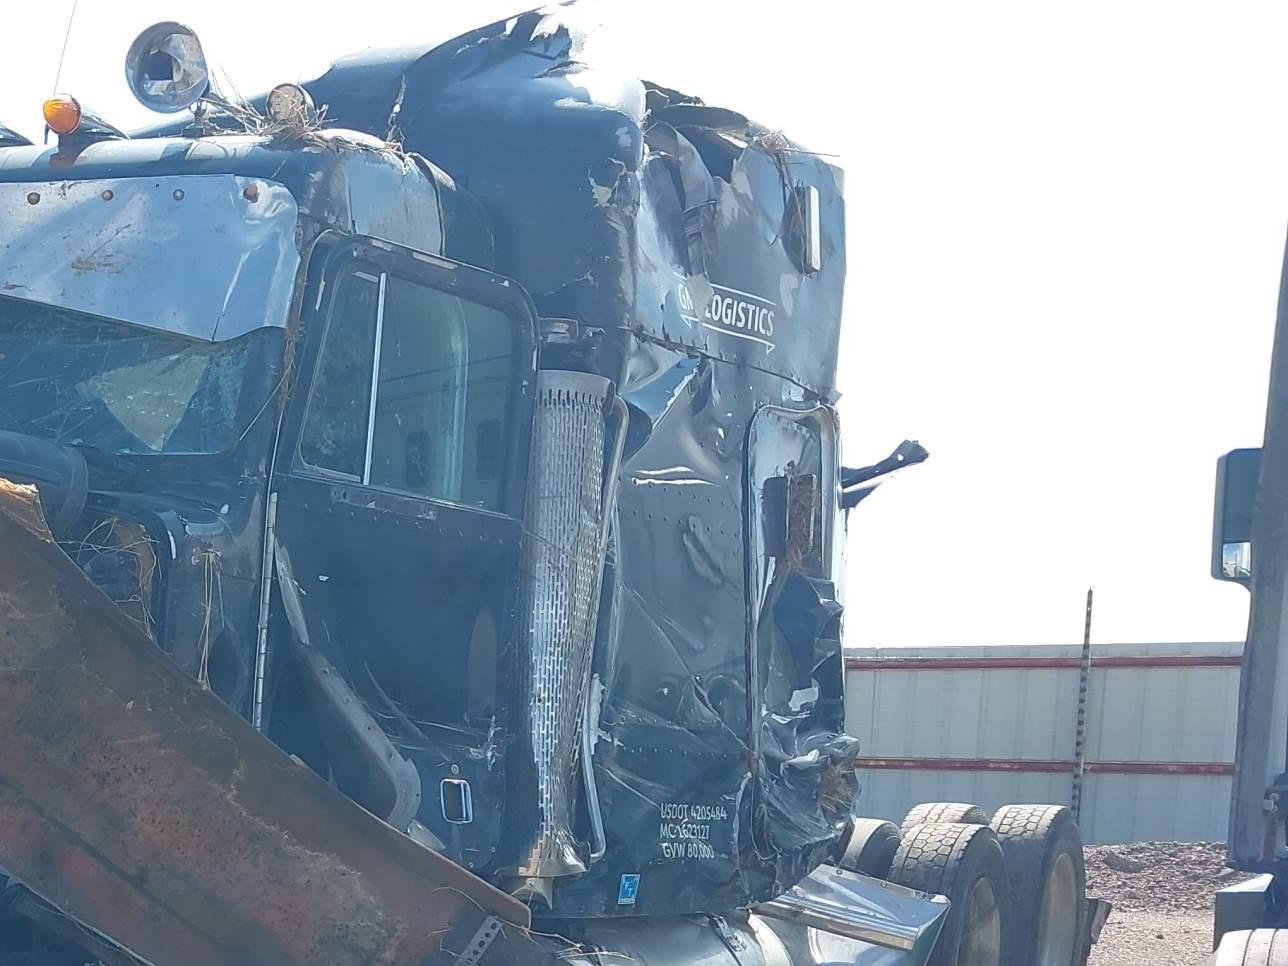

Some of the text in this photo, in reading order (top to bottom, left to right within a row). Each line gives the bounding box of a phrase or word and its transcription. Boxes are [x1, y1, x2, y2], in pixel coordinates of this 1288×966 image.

[660, 803, 728, 821] USDOT 4205484
[661, 842, 715, 861] GVW 80,000
